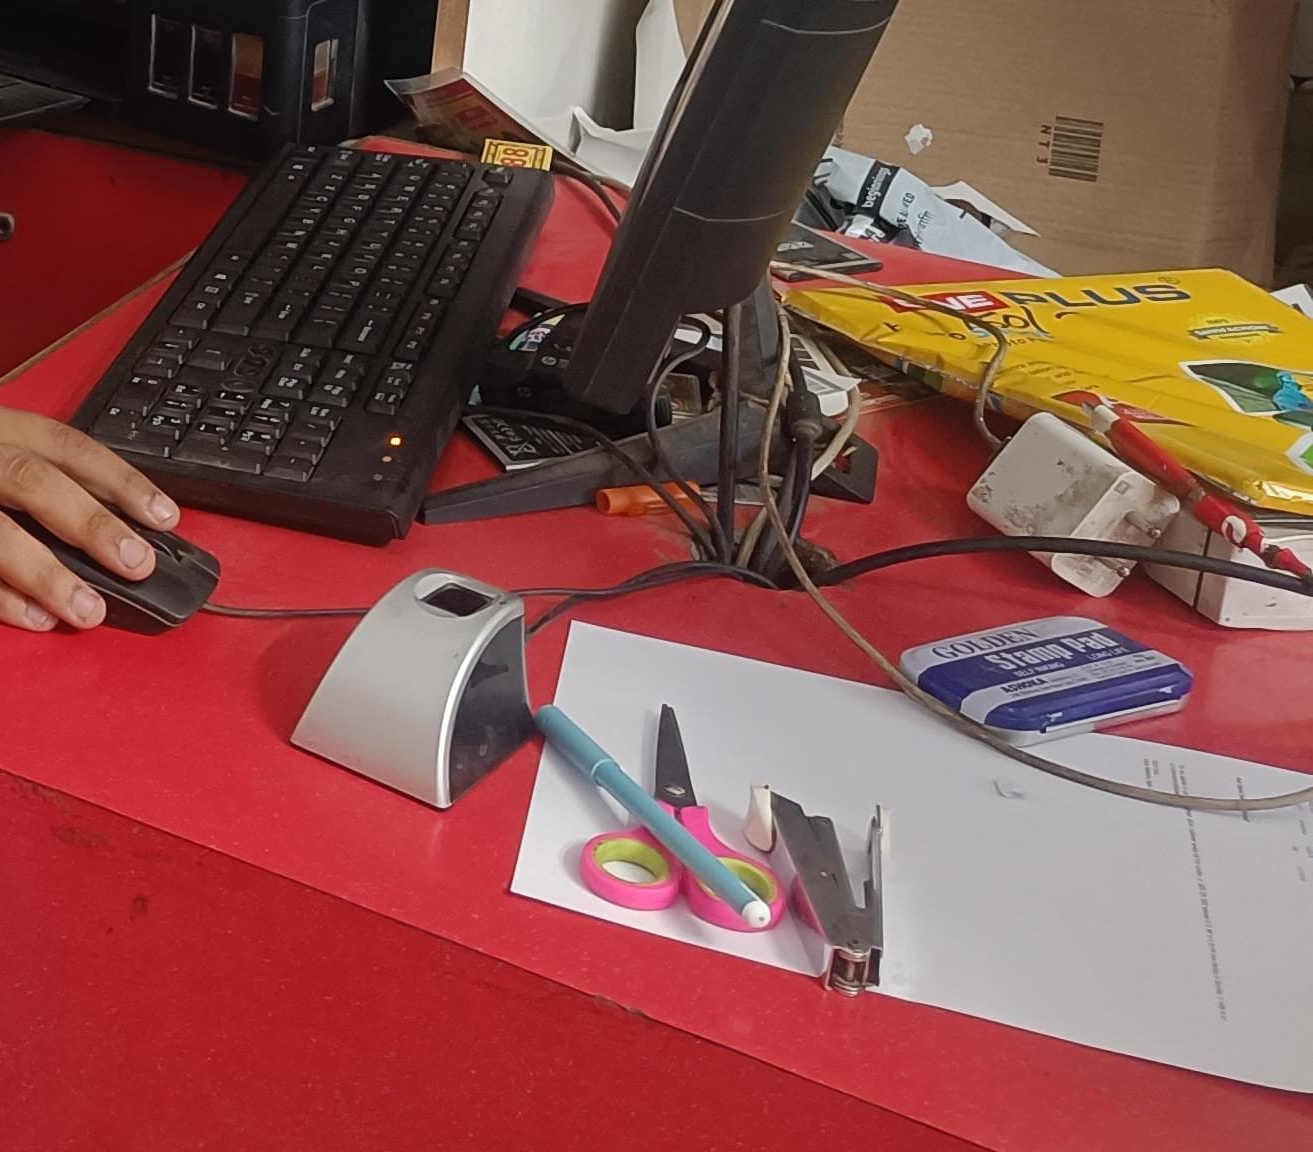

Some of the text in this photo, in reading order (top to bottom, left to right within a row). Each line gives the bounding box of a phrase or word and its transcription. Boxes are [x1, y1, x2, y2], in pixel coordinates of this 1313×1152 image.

[1001, 281, 1192, 308] PLUS
[932, 627, 1040, 662] GOLDEN
[984, 642, 1075, 671] Stamp
[1061, 632, 1120, 654] Pad
